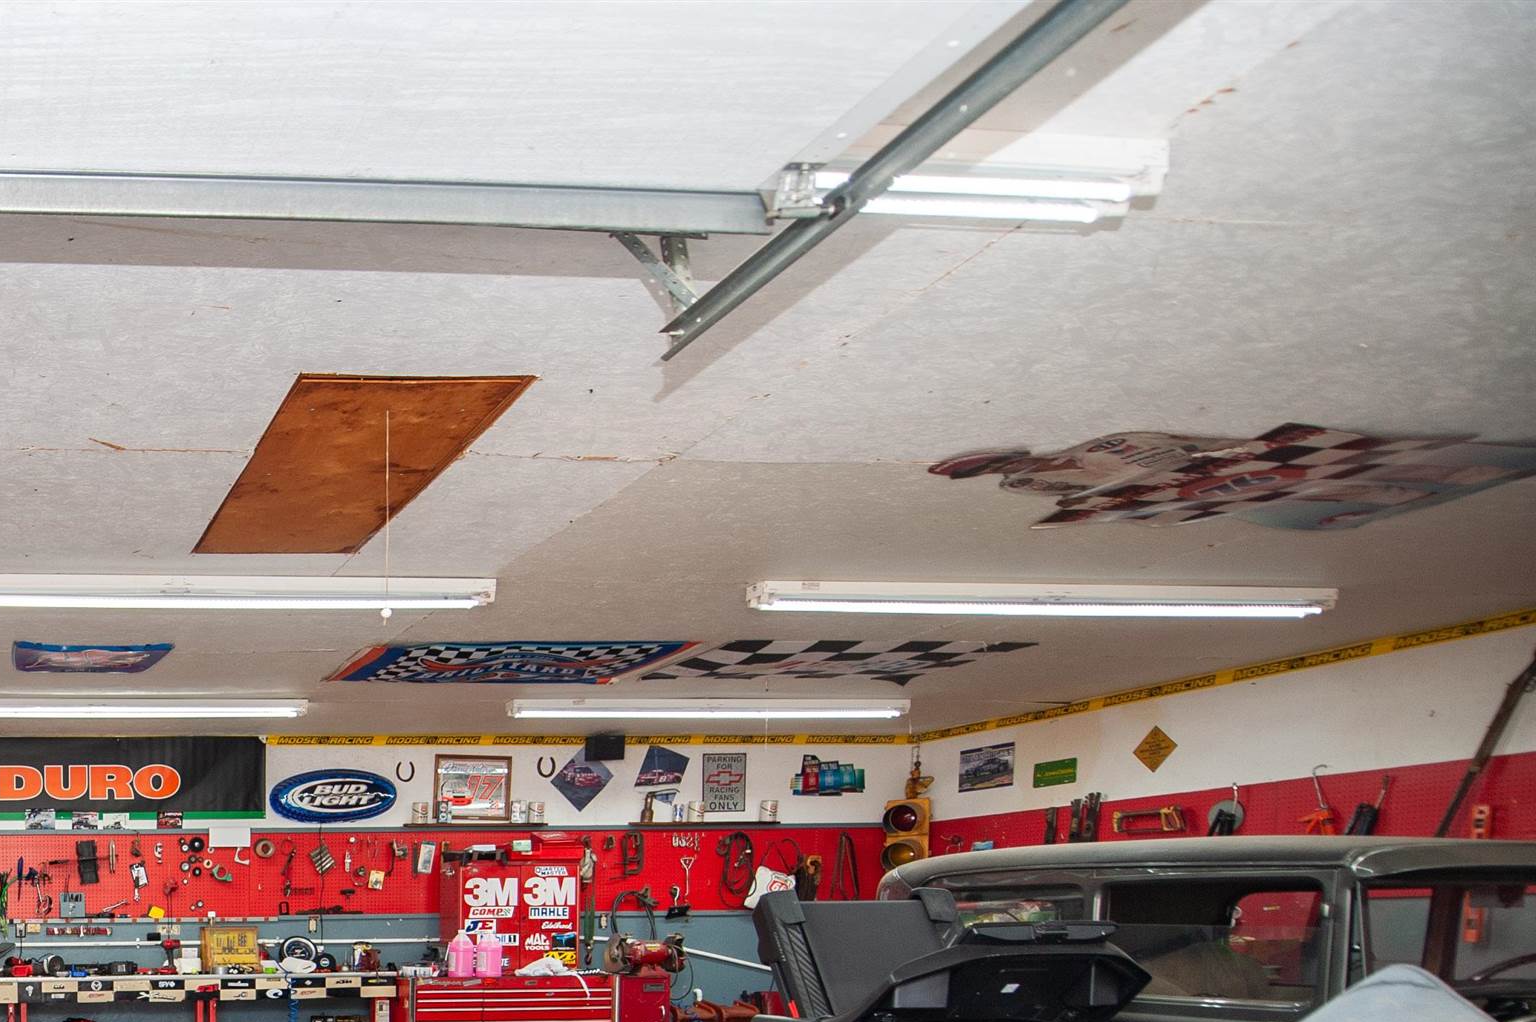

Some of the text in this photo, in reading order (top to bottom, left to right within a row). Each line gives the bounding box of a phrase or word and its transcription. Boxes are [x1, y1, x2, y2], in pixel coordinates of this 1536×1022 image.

[1235, 643, 1372, 681] MOOSE RACING
[1103, 674, 1216, 707] MOOSE RACING
[1044, 701, 1090, 719] RACING
[277, 736, 373, 745] MOOSE RACING
[385, 736, 480, 744] MOOSE RACING
[493, 736, 533, 744] MOOSE
[648, 736, 690, 744] RACING
[703, 736, 742, 744] MOOSE
[854, 736, 895, 744] RACING
[314, 784, 368, 795] BUD
[302, 795, 372, 806] LIGHT
[714, 793, 735, 801] FANS
[709, 801, 739, 810] ONLY
[464, 877, 519, 907] 3M
[524, 876, 576, 906] 3M
[472, 908, 504, 916] COMP
[530, 907, 568, 917] MAHLE
[465, 920, 494, 932] JE
[525, 933, 550, 945] MAC
